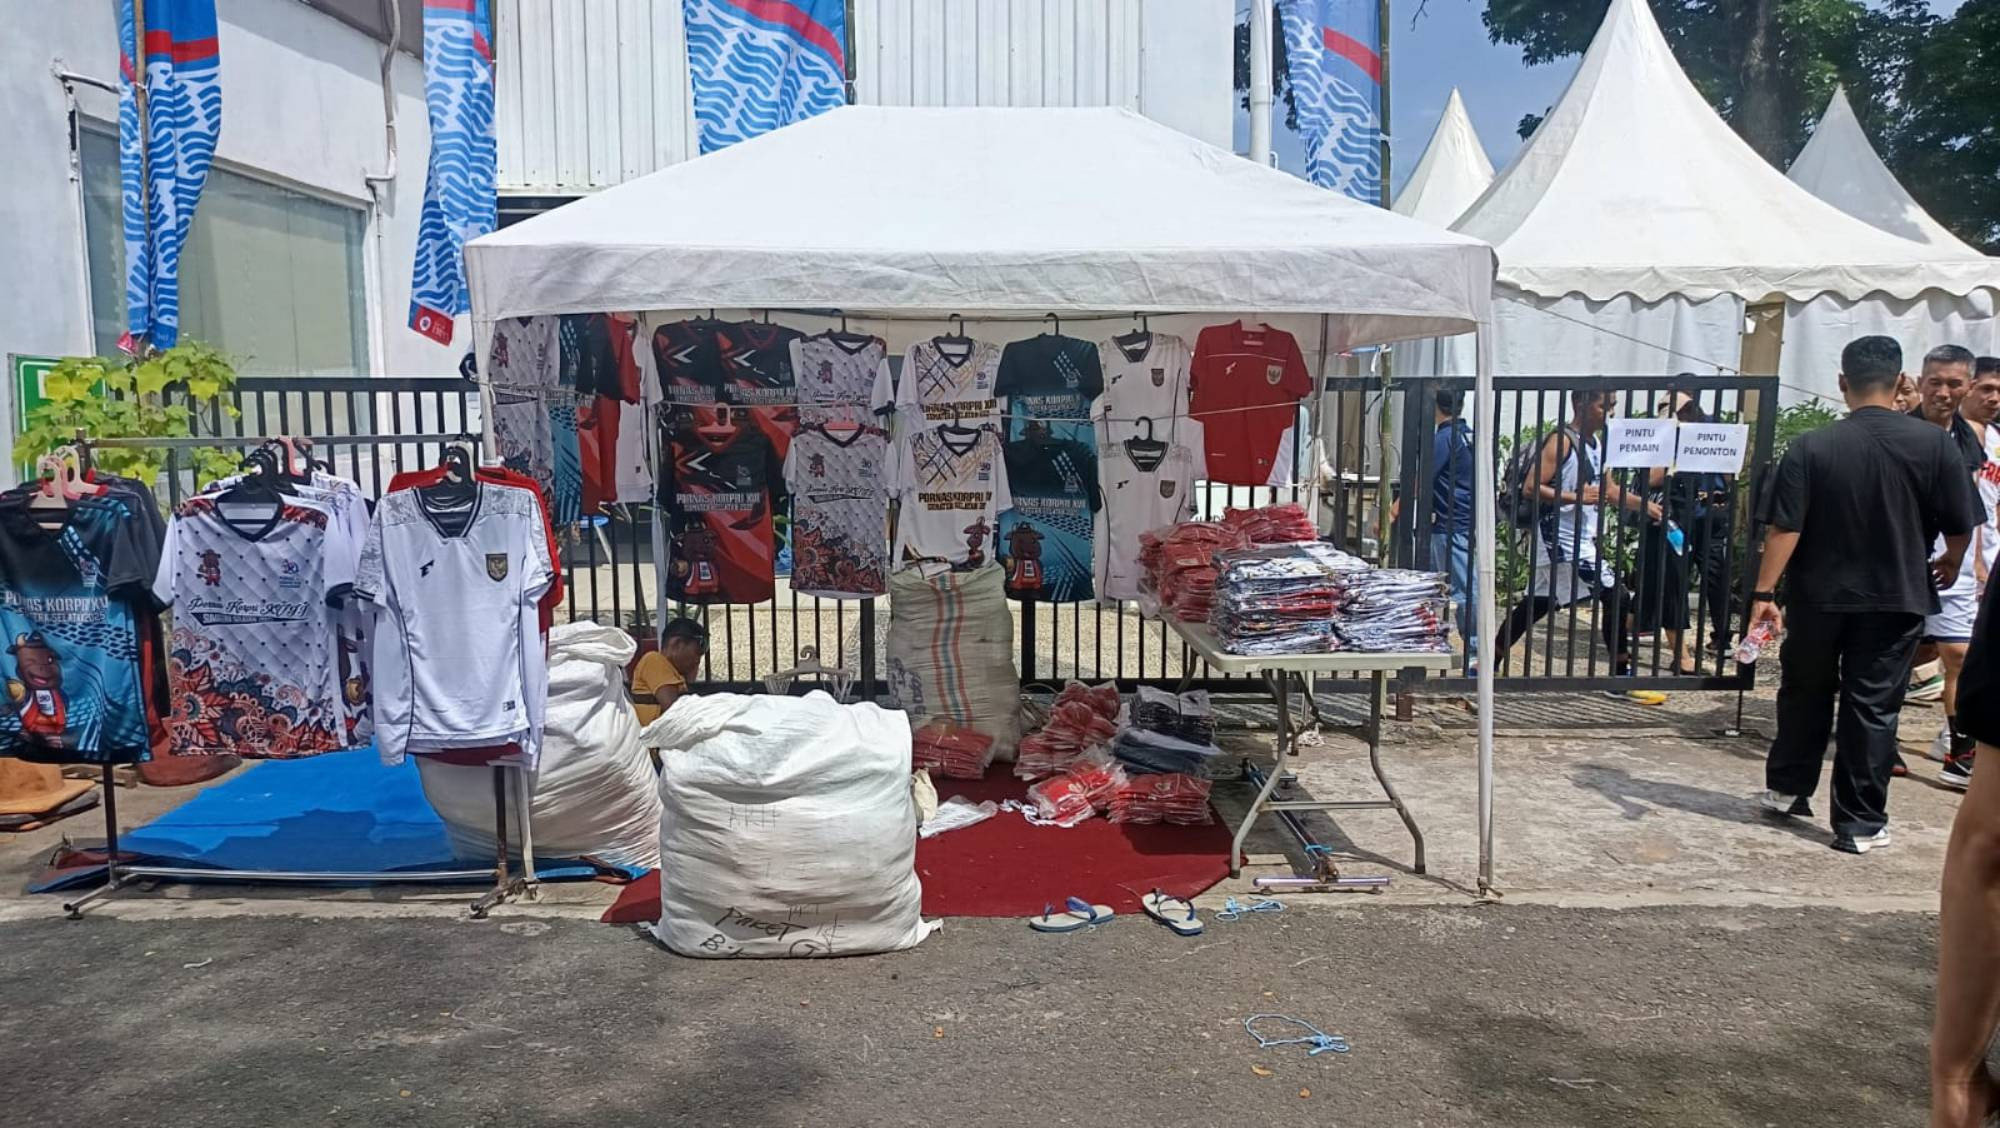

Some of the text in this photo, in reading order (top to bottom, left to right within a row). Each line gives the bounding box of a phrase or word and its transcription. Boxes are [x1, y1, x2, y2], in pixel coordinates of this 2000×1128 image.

[1625, 429, 1655, 437] PINTU
[1697, 433, 1726, 442] PINTU
[1619, 444, 1660, 453] PEMAIN
[1684, 447, 1737, 456] PENONTON
